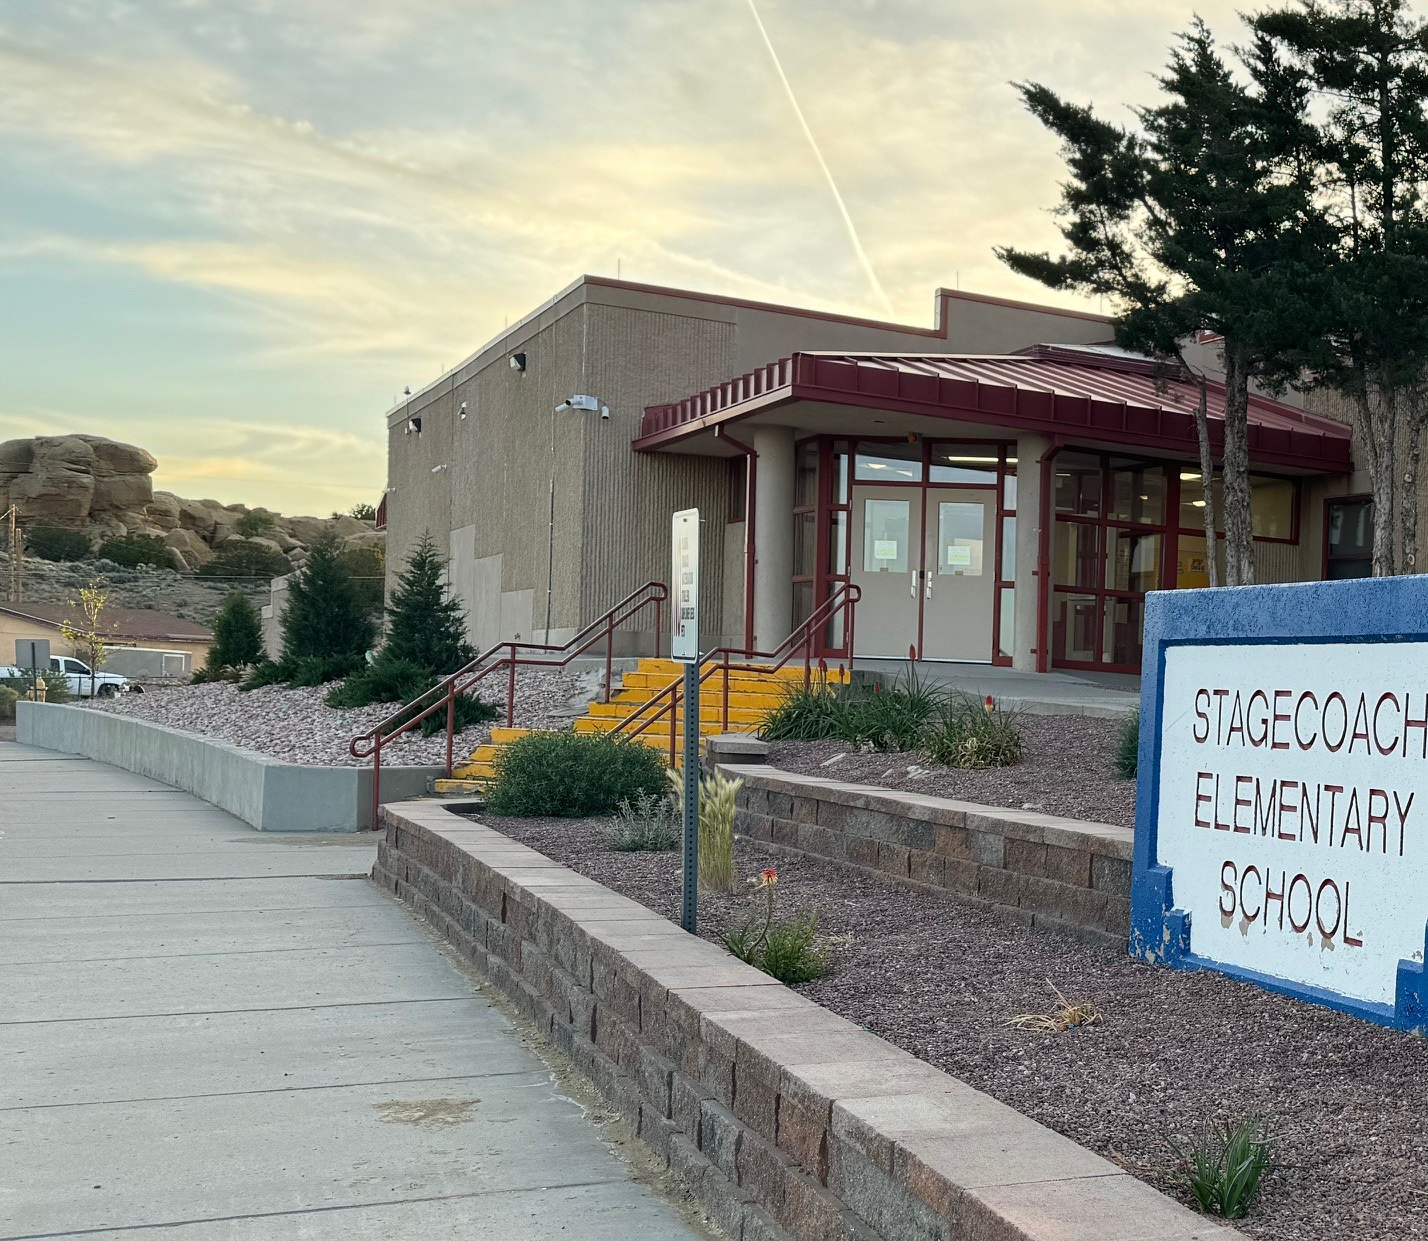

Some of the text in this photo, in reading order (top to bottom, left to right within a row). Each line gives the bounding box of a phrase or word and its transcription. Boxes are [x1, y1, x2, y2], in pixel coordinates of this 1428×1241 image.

[1193, 688, 1428, 759] STAGECOACH
[1194, 772, 1414, 856] ELEMENTARY
[1219, 860, 1363, 947] SCHOOL
